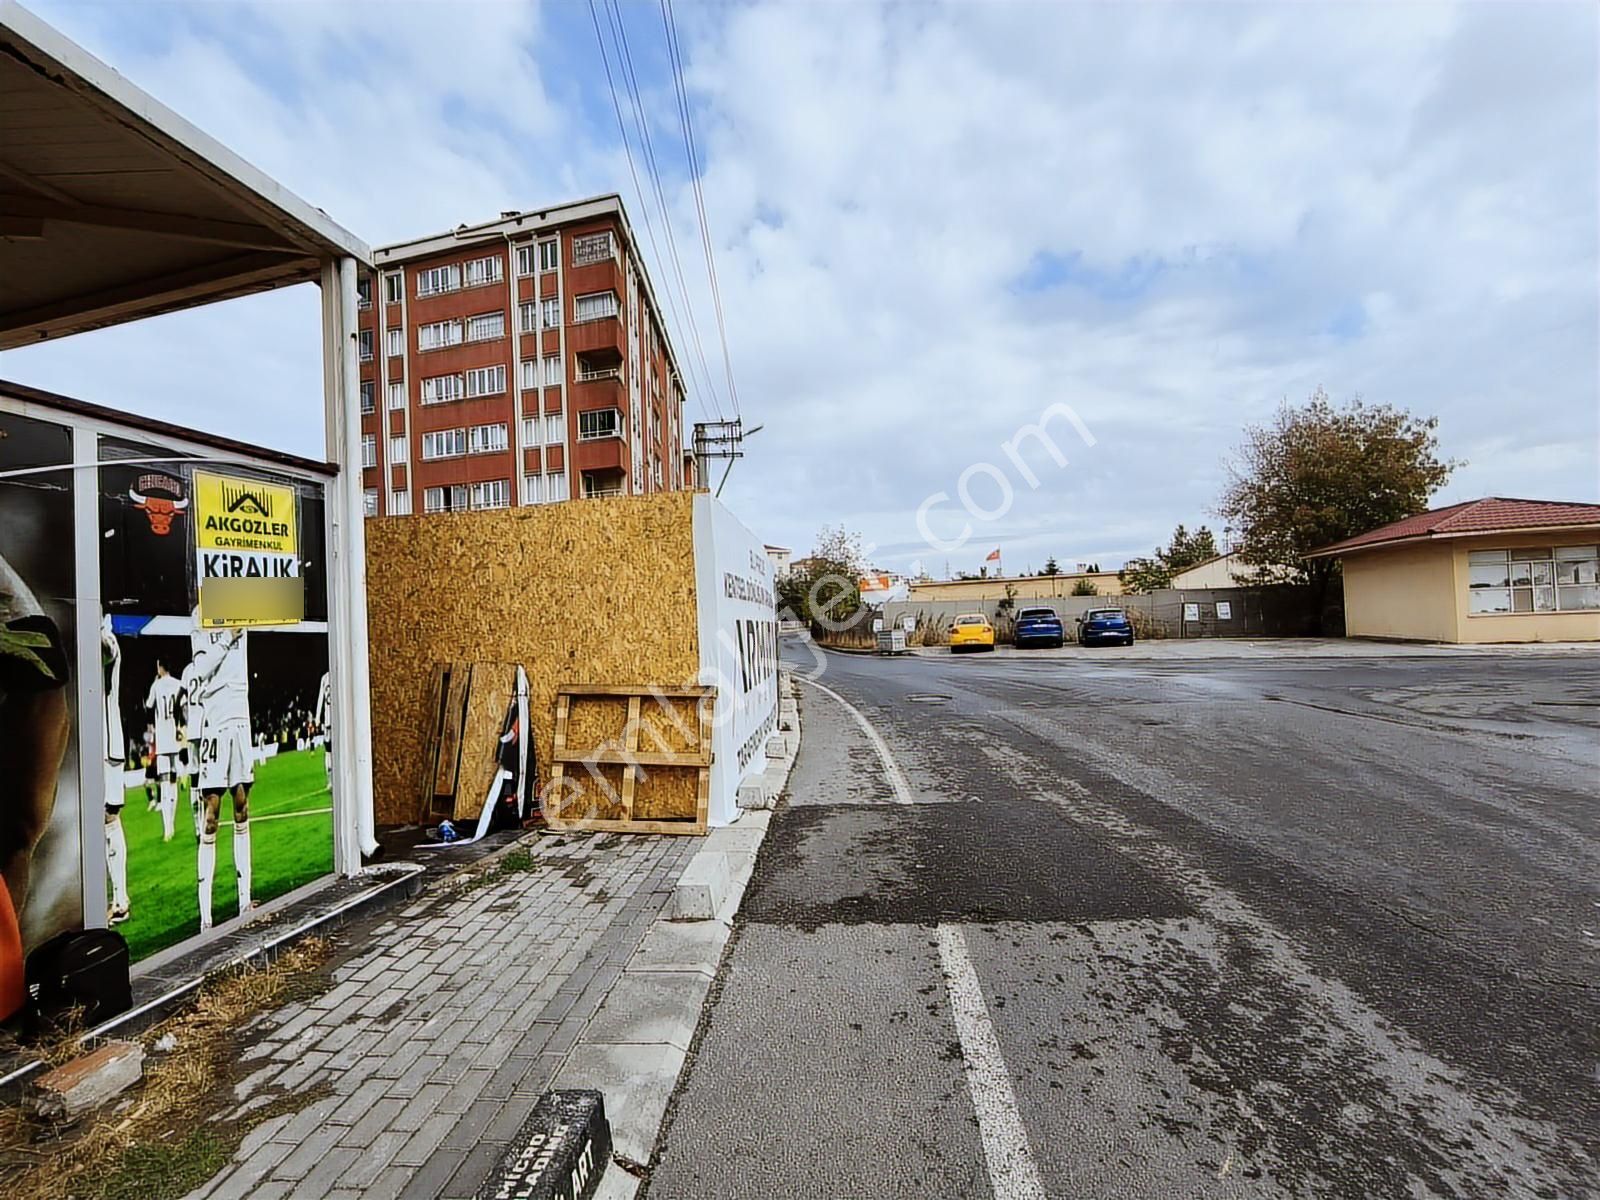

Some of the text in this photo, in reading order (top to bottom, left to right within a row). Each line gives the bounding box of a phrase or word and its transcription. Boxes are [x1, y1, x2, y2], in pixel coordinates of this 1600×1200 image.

[215, 536, 283, 550] GAYRİMENKUL
[201, 738, 218, 764] 24
[495, 1134, 547, 1199] MICRO
[513, 1124, 570, 1200] LADING
